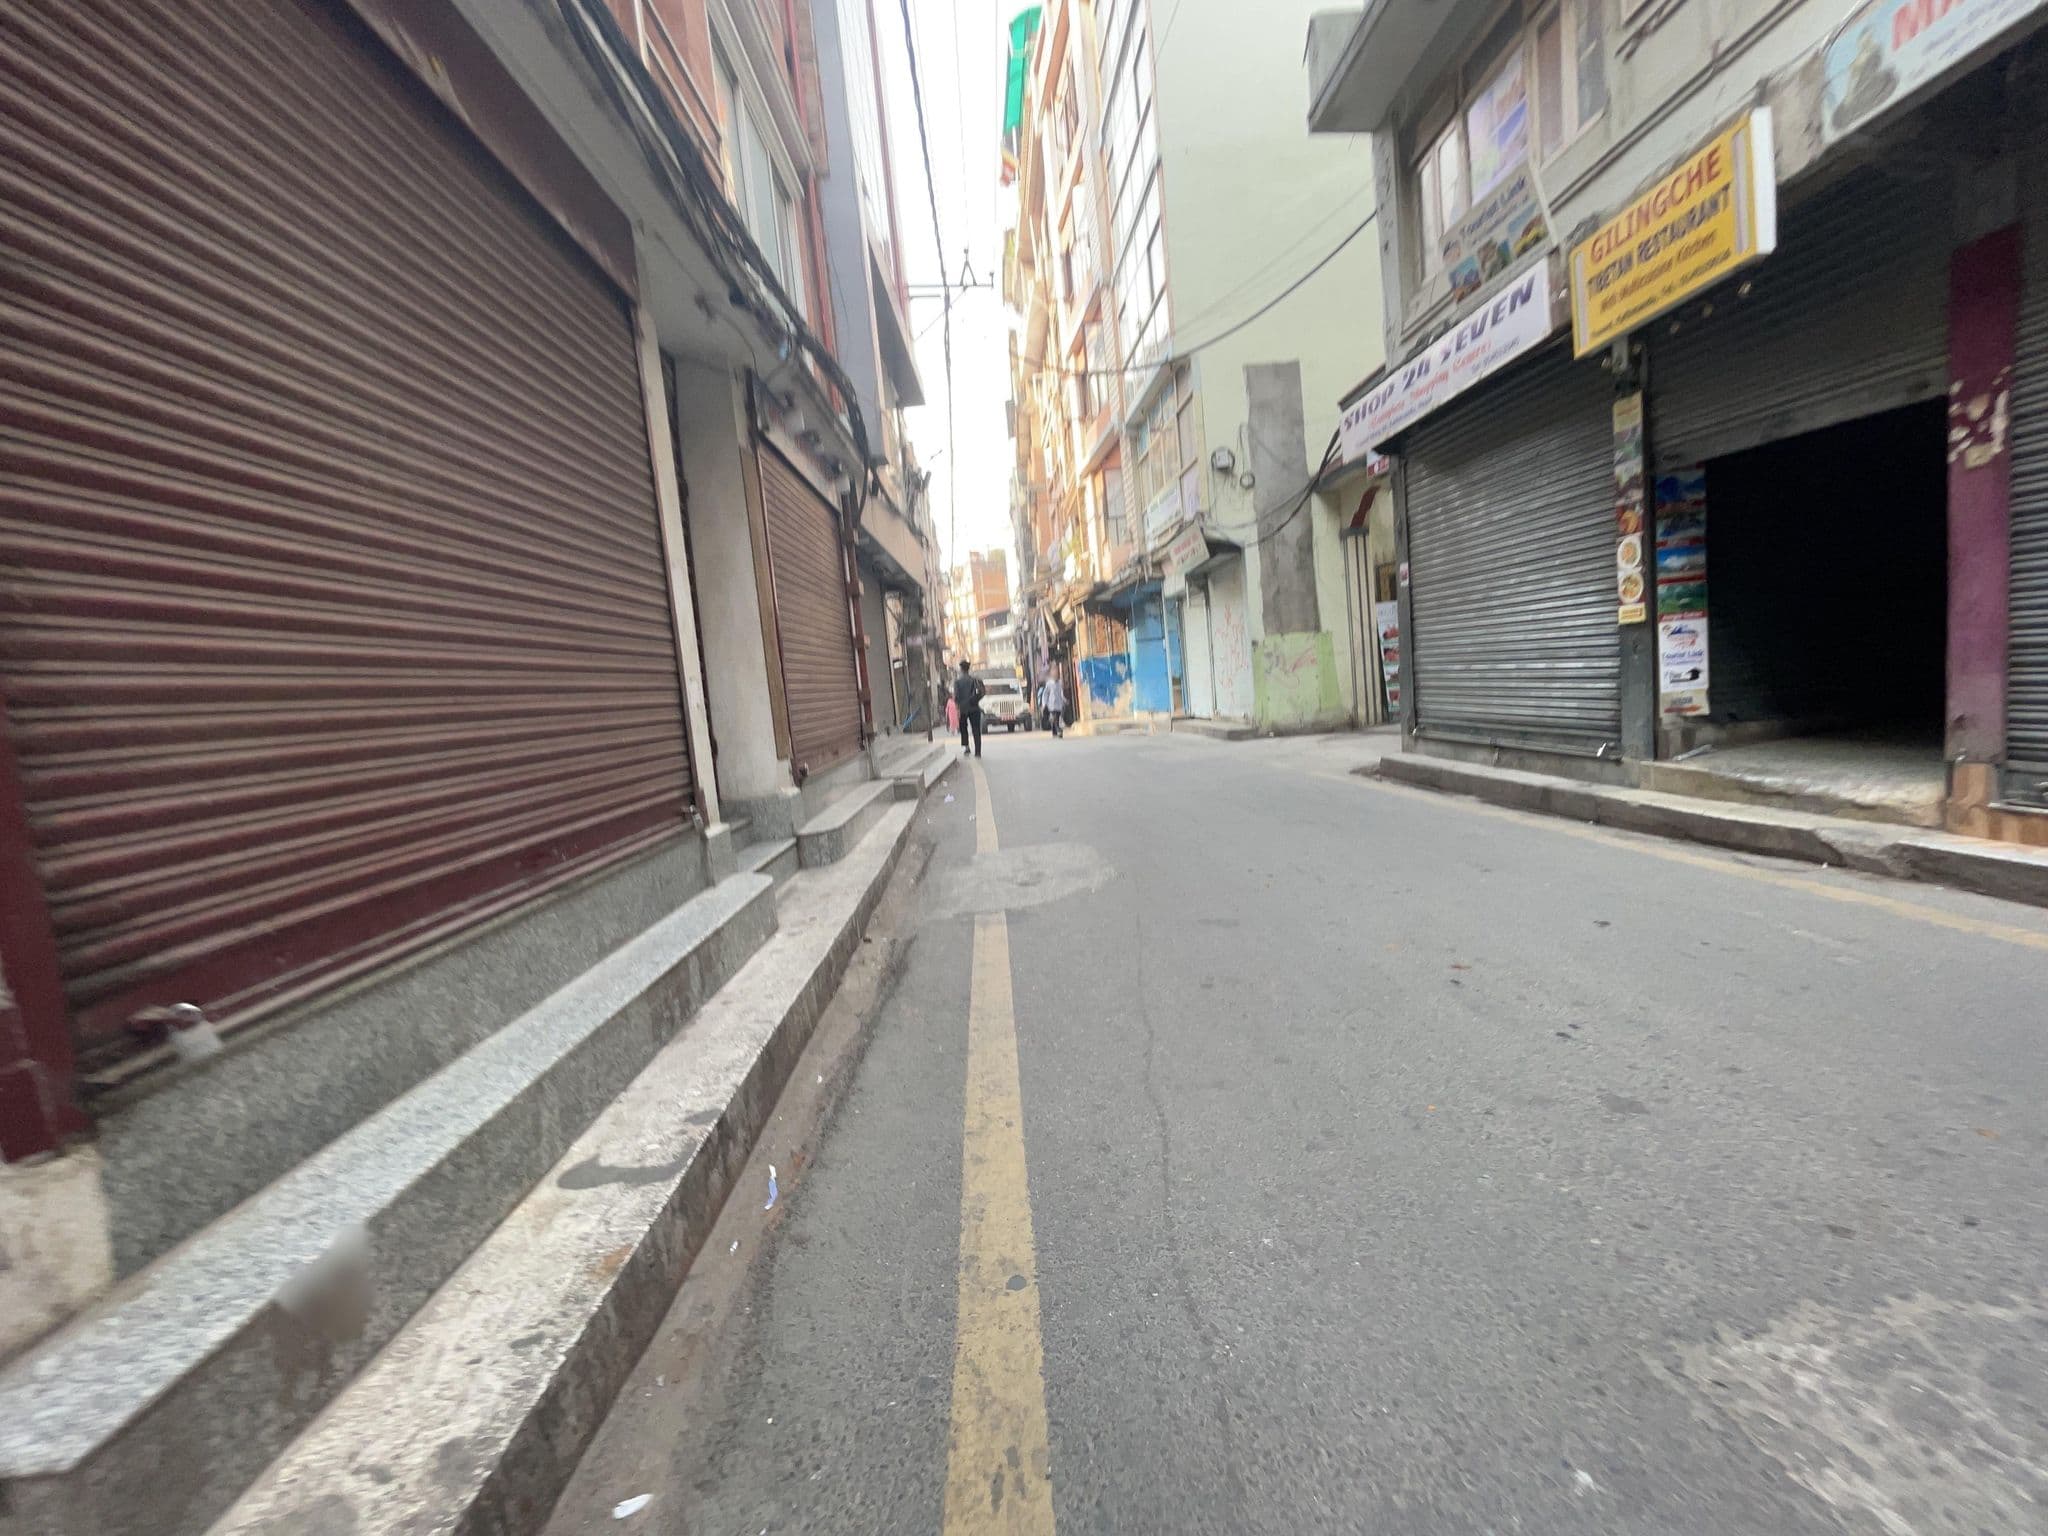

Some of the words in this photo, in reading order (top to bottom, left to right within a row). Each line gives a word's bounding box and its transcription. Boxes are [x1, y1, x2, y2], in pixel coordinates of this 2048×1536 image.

[1591, 144, 1722, 264] GILINGCHE
[1637, 183, 1731, 264] RESTAURANT
[1344, 383, 1395, 432] SHOP
